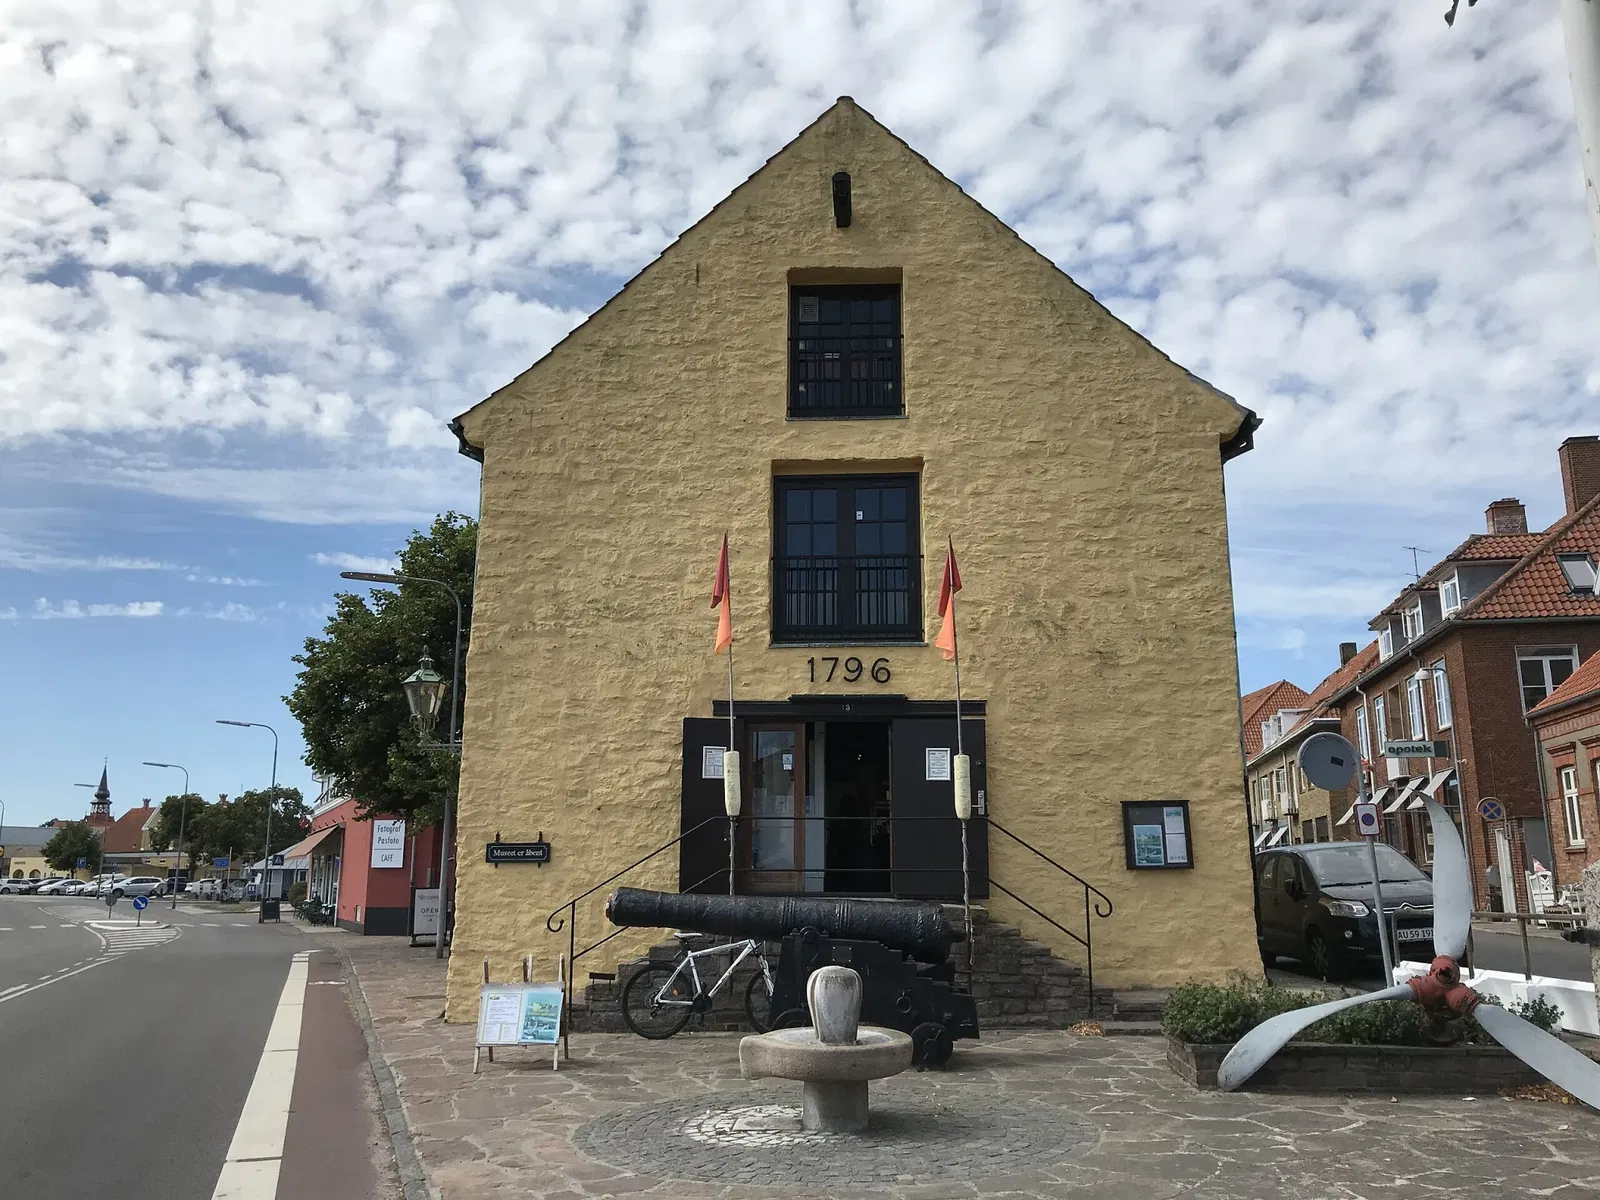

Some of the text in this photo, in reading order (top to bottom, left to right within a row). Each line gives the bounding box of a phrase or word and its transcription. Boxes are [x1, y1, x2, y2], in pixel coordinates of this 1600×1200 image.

[807, 657, 891, 683] 1796
[1388, 744, 1432, 755] apotek
[377, 825, 402, 834] Fotograf
[377, 836, 400, 845] Pasfoto
[493, 849, 516, 857] Museet
[1398, 930, 1409, 939] AU
[1409, 930, 1420, 938] 59
